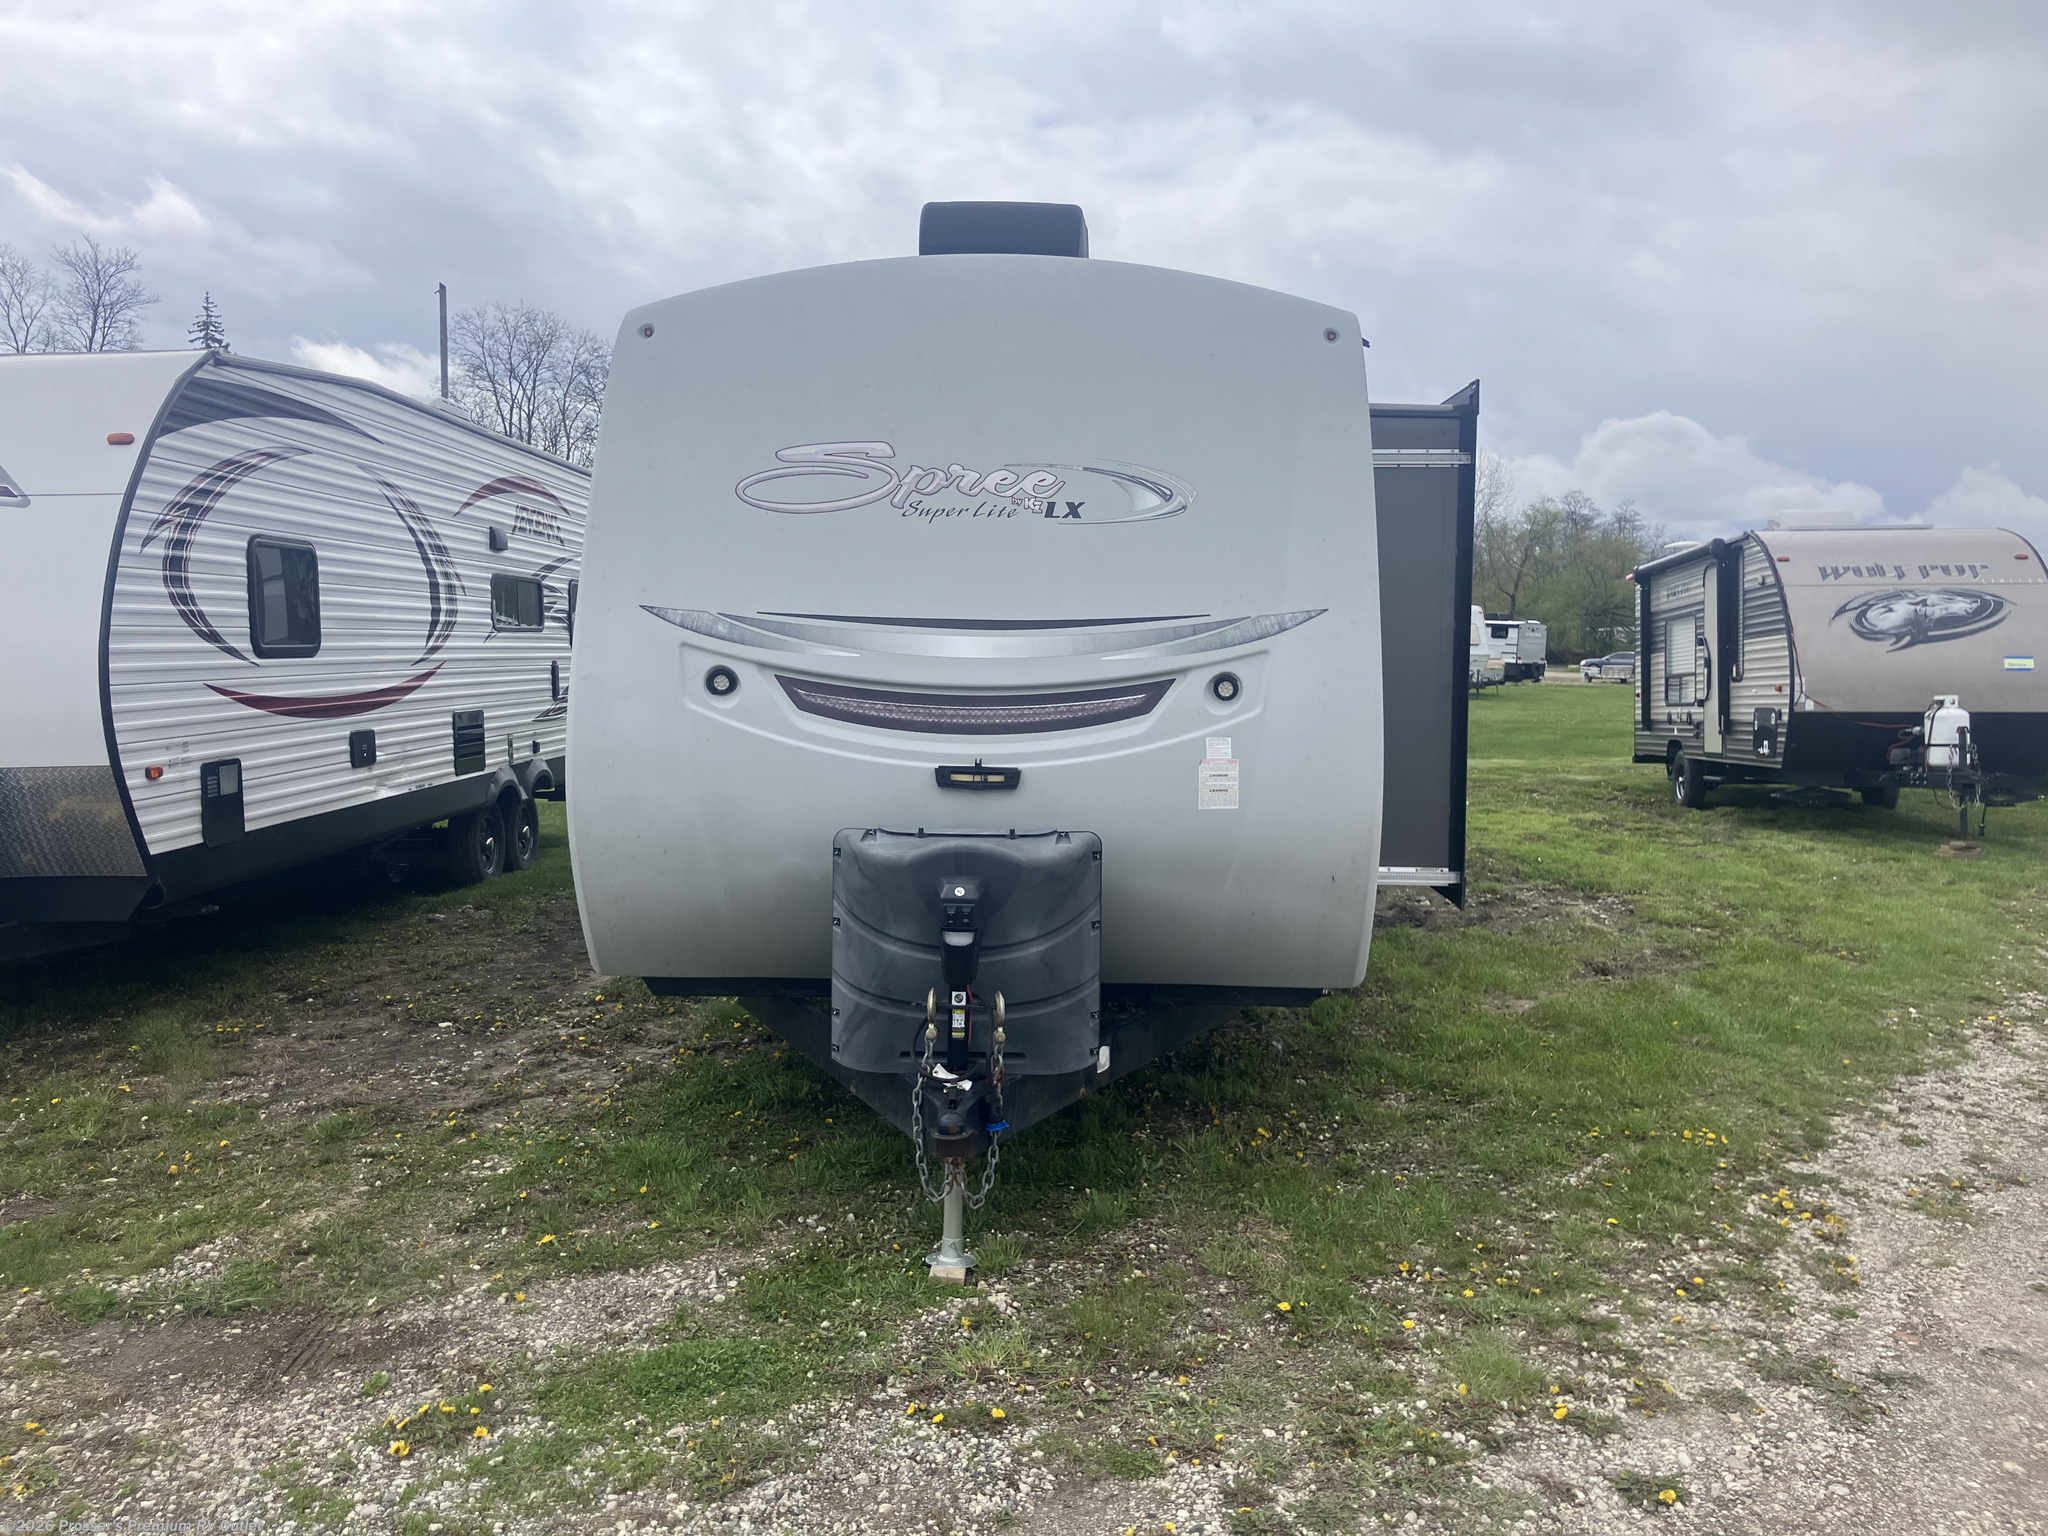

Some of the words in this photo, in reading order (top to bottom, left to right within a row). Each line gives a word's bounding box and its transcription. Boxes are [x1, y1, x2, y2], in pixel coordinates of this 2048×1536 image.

[735, 440, 1066, 514] Spree
[902, 500, 969, 524] Super
[973, 501, 1020, 519] Lite
[1044, 501, 1085, 519] LX
